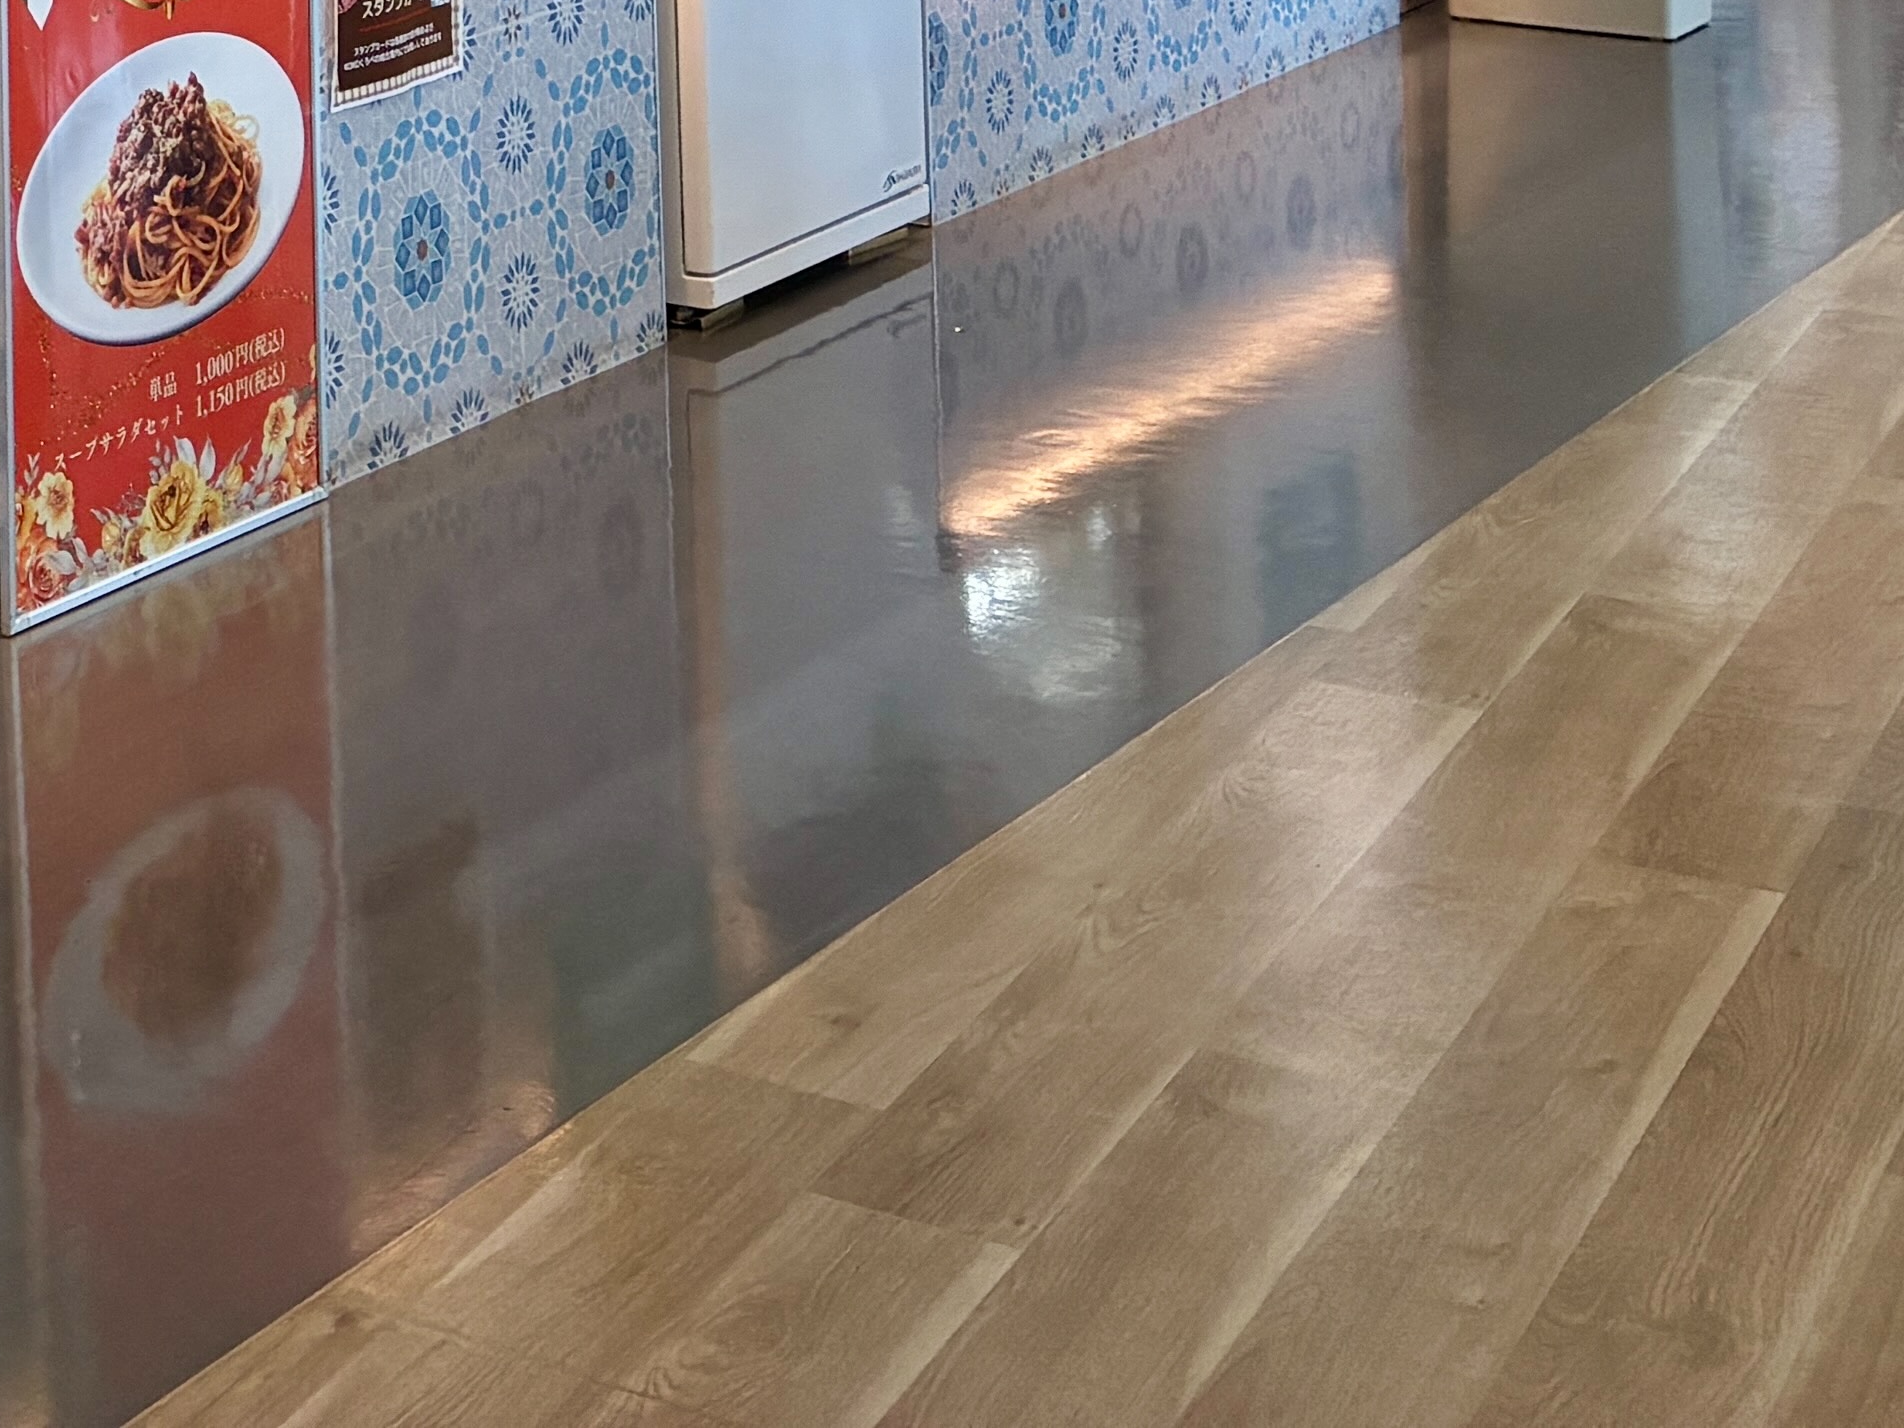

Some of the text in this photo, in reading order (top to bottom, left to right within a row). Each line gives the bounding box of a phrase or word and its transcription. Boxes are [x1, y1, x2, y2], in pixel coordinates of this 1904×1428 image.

[149, 328, 286, 403] 単品 1,000円(税込)
[54, 361, 287, 472] スープサラダセット 1,150円(税込)
